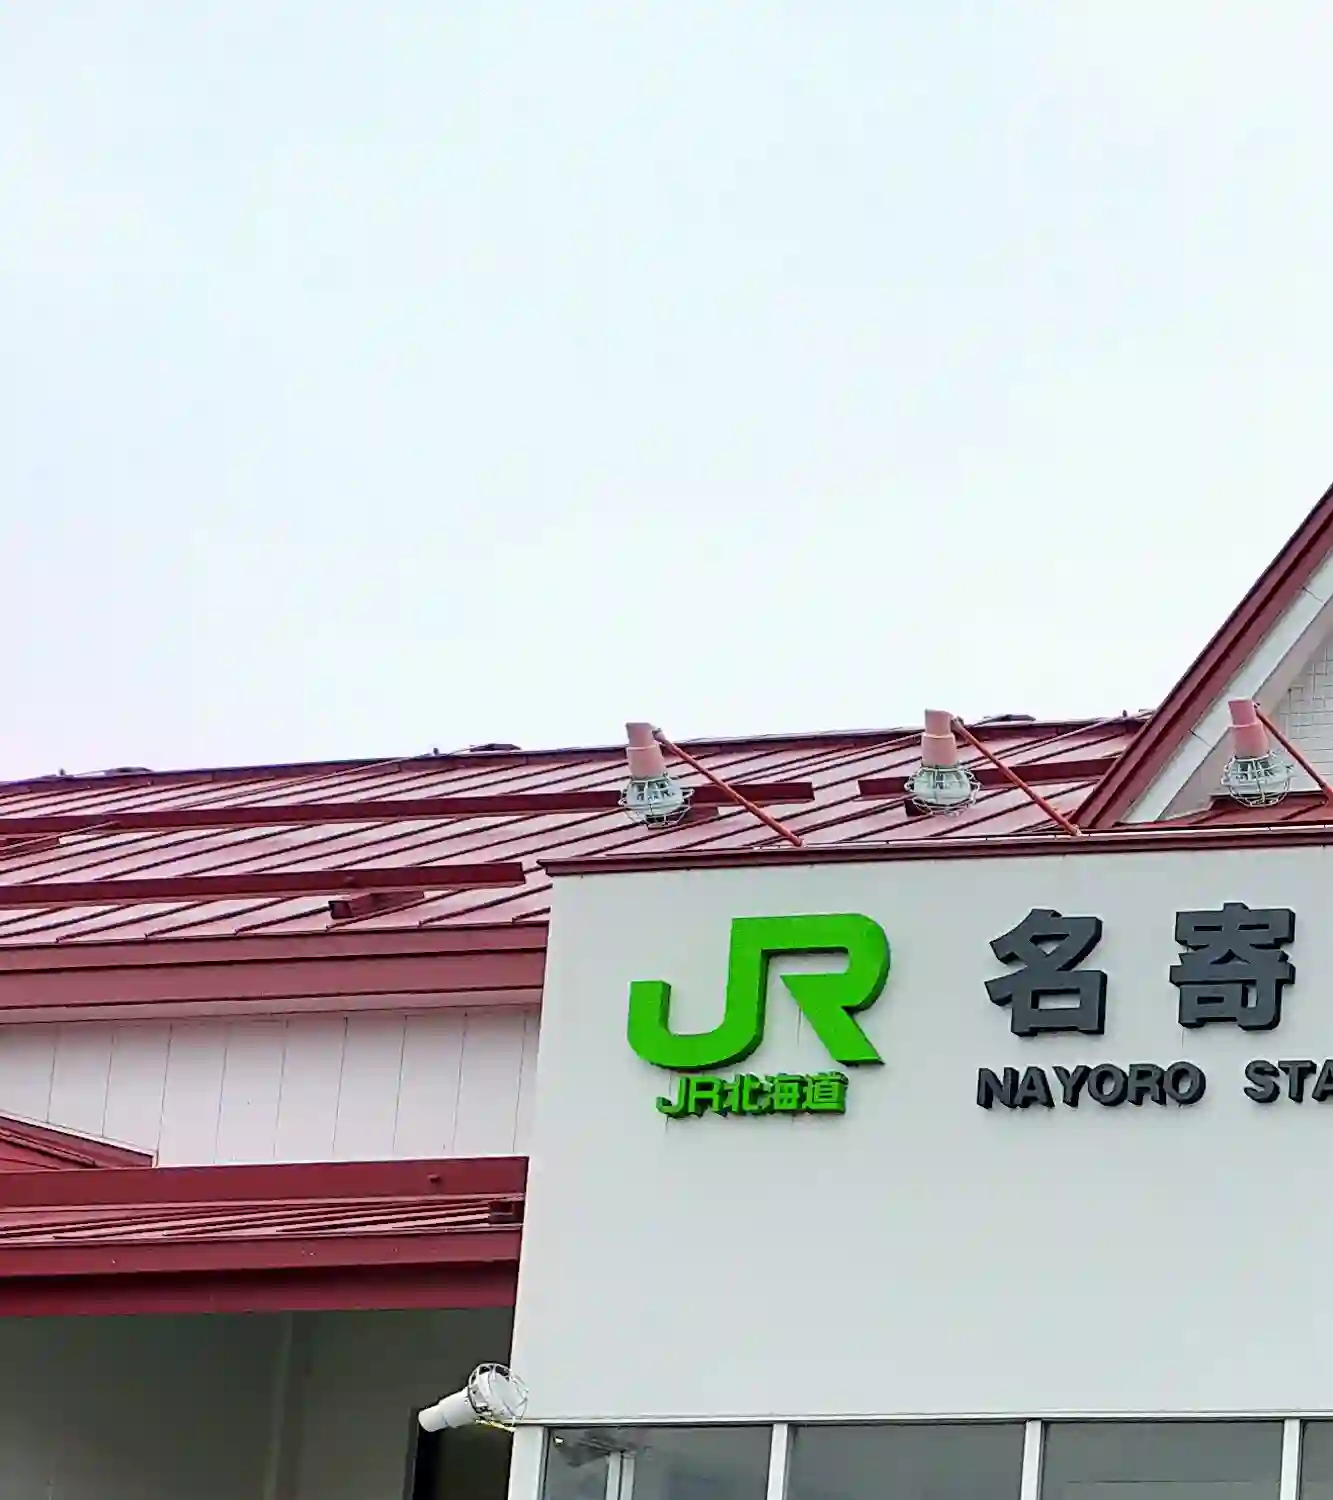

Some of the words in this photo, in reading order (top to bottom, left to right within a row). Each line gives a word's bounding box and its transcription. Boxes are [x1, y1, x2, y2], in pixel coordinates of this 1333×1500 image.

[627, 912, 889, 1071] JR
[657, 1070, 849, 1119] JR北海道
[977, 1059, 1206, 1109] NAYORO
